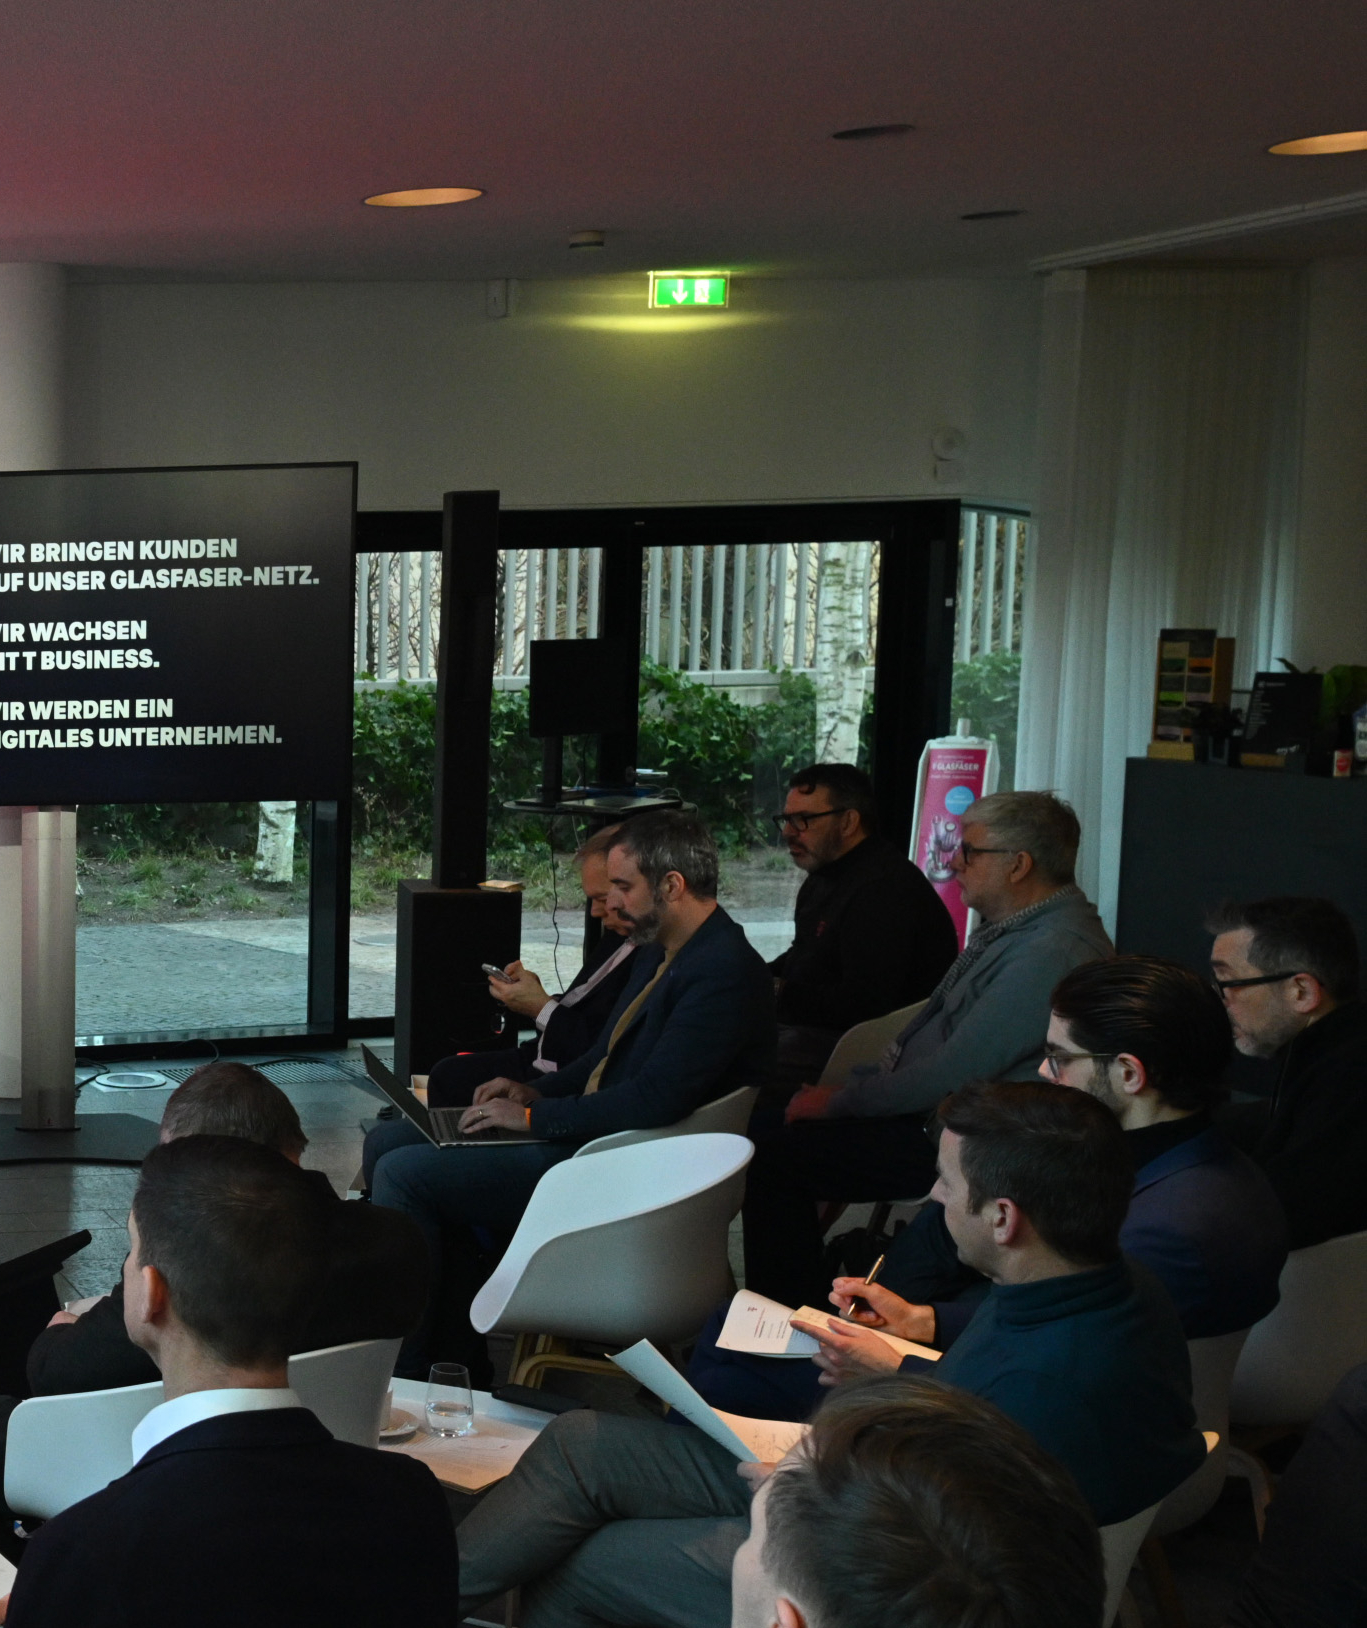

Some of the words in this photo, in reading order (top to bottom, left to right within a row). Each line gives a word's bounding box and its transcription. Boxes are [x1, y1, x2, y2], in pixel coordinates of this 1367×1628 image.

[30, 540, 135, 563] BRINGEN
[139, 537, 238, 560] KUNDEN
[28, 570, 106, 592] UNSER
[110, 565, 320, 590] GLASFASER-NETZ.
[29, 619, 148, 642] WACHSEN
[21, 650, 37, 671] T
[40, 648, 160, 671] BUSINESS.
[29, 699, 130, 720] WERDEN
[135, 698, 174, 718] EIN
[98, 724, 282, 747] UNTERNEHMEN.
